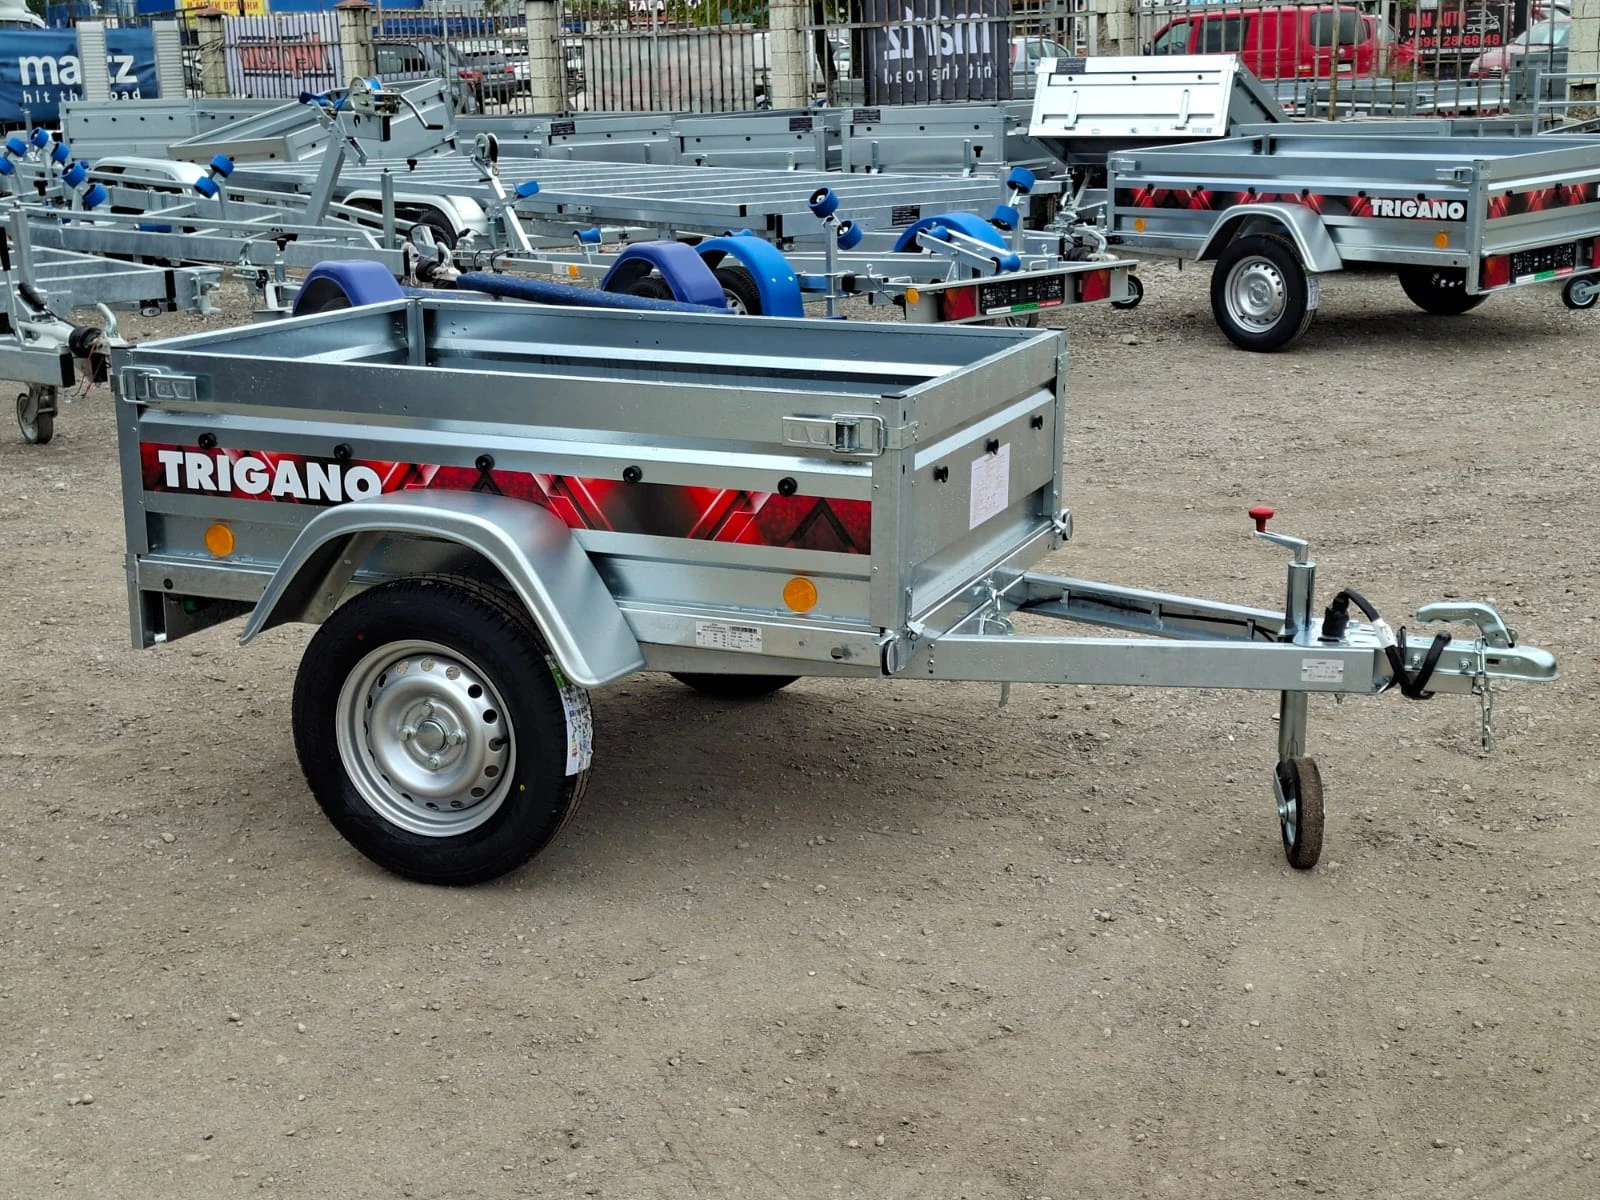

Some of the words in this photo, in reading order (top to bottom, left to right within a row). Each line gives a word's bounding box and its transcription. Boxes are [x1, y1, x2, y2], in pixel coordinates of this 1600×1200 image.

[1409, 12, 1432, 28] DM
[1463, 35, 1480, 46] 68
[1485, 34, 1501, 45] 48
[19, 55, 138, 86] maz
[23, 89, 51, 103] hit
[60, 88, 84, 103] th
[1370, 199, 1465, 220] TRIGANO
[158, 450, 383, 502] TRIGANO
